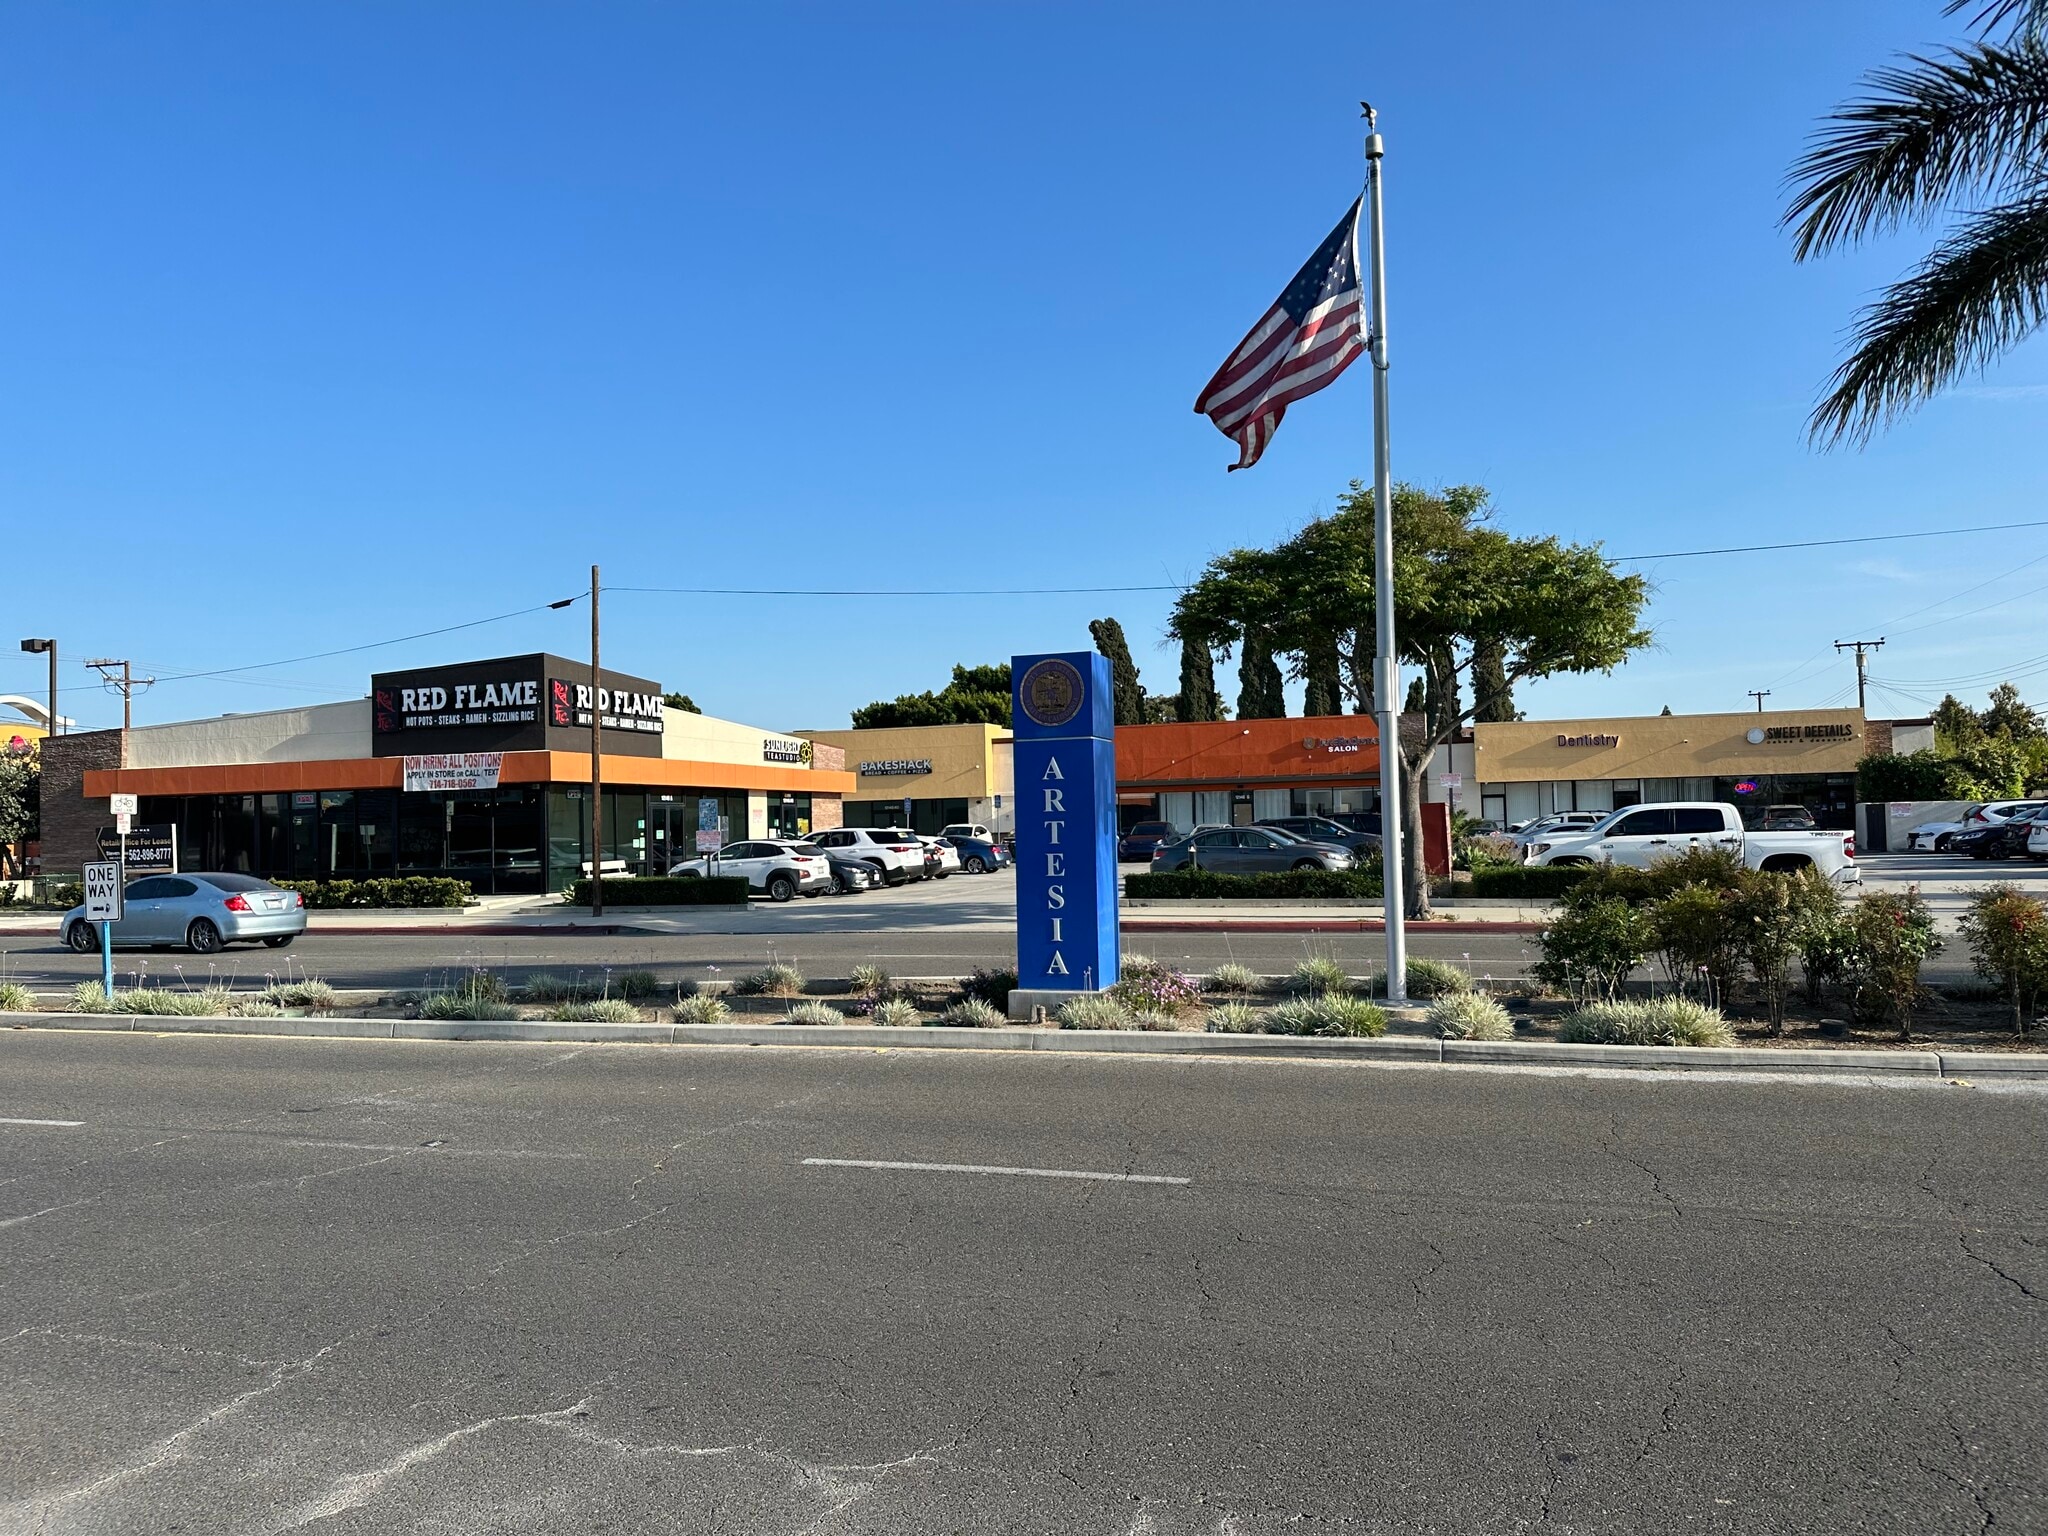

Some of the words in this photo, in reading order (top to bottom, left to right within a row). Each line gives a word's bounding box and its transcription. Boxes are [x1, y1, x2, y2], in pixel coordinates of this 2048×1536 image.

[401, 687, 447, 712] RED
[454, 681, 537, 709] FLAME
[613, 690, 664, 717] FLAME
[406, 716, 417, 727] HOT
[418, 715, 433, 727] POTS
[438, 714, 461, 726] STEAKS
[465, 713, 488, 724] RAMEN
[492, 711, 520, 722] SIZZLING
[520, 710, 535, 721] RICE
[1766, 726, 1801, 740] SWEET
[1804, 724, 1852, 738] DEETAILS
[1557, 733, 1619, 749] Dentistry
[1328, 745, 1358, 753] SALON
[423, 755, 447, 770] HIRING
[449, 754, 462, 769] ALL
[464, 753, 502, 768] POSITIONS
[861, 759, 931, 771] BAKESHACK
[465, 769, 480, 777] CALL
[484, 768, 499, 776] TEXT
[429, 779, 476, 789] 714-718-0562
[1735, 783, 1755, 792] OPEN
[128, 848, 171, 860] 562-896-8777
[1042, 756, 1070, 975] ARTESIA
[88, 867, 114, 881] ONE
[88, 883, 115, 898] WAY
